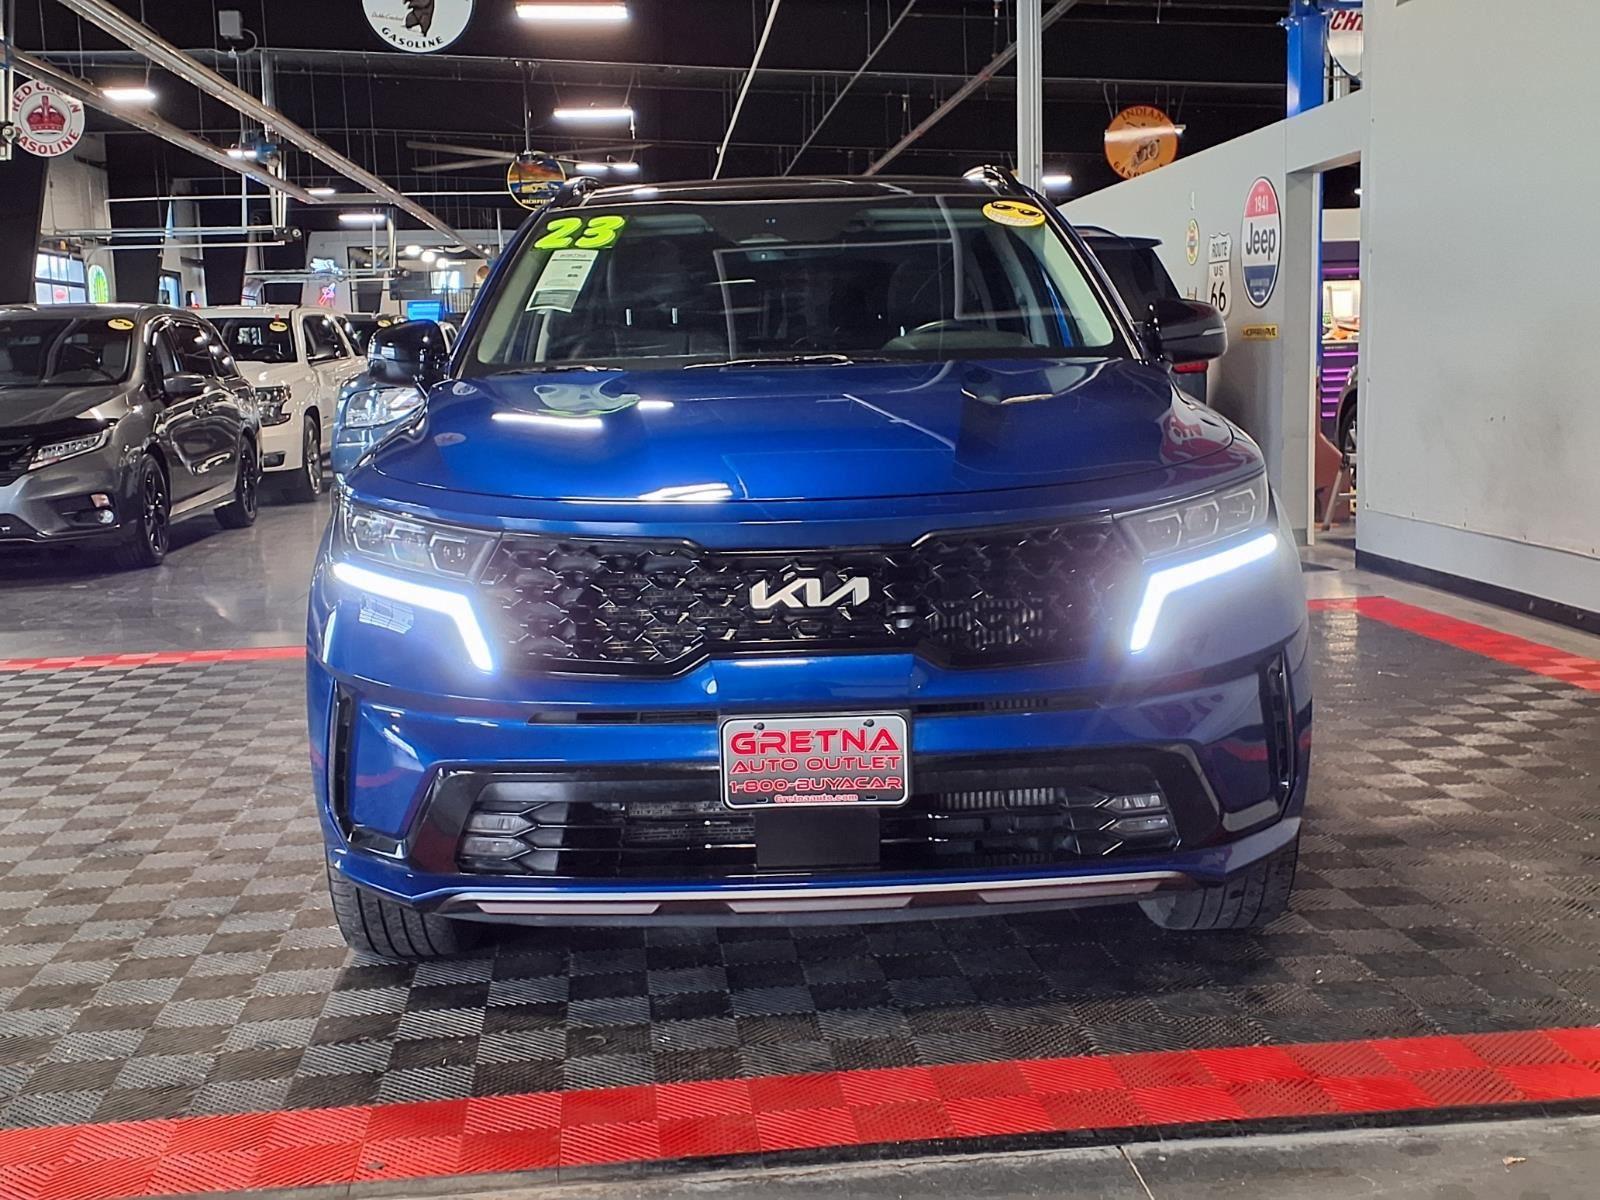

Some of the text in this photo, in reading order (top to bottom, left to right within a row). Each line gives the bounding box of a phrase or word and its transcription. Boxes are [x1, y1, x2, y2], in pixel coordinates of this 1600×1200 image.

[382, 27, 444, 48] GASOLINE
[1119, 107, 1165, 122] INDIAN
[1254, 195, 1269, 212] 1941
[533, 214, 626, 250] 23
[1245, 222, 1276, 261] Jeep
[1211, 241, 1228, 258] ROUTE
[1213, 265, 1224, 277] US
[1210, 281, 1227, 312] 66
[748, 577, 869, 609] KIA
[729, 727, 900, 756] GRETNA
[729, 755, 902, 775] AUTO OUTLET
[729, 775, 903, 793] 1-800-BUYACAR
